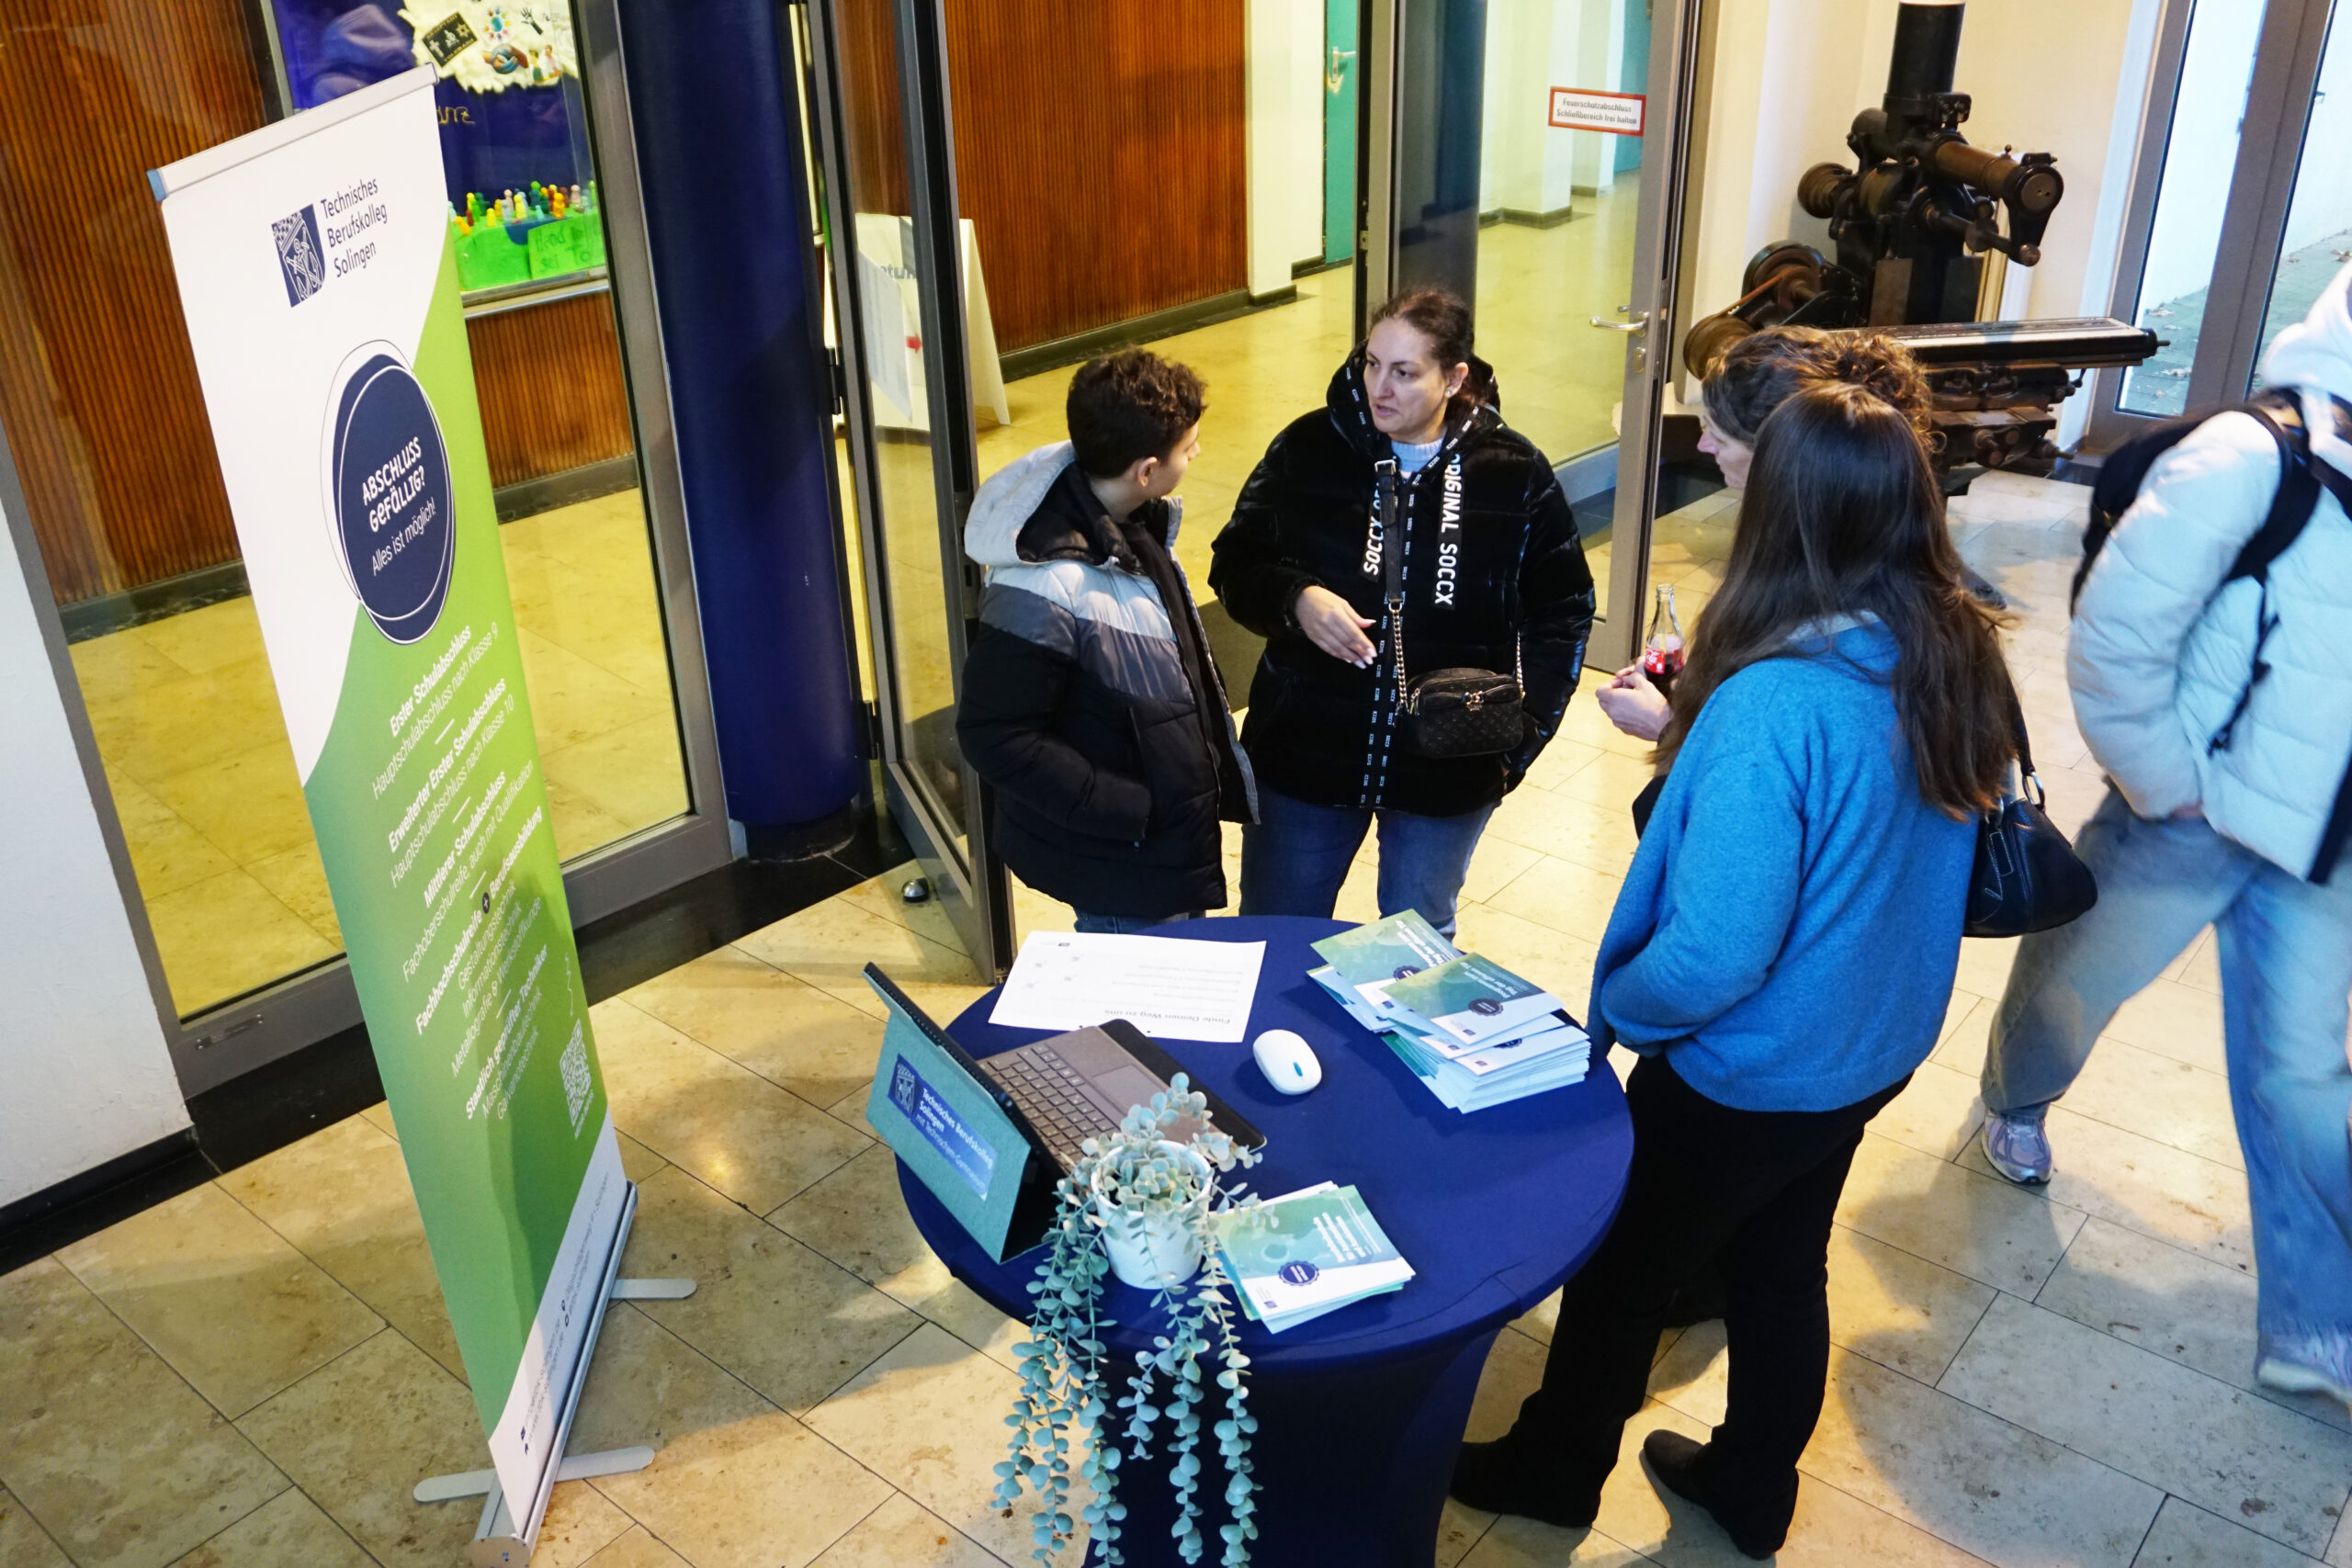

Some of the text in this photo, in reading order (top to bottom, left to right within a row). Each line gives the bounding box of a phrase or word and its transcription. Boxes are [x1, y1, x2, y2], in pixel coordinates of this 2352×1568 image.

[1556, 108, 1603, 121] Schließbereich
[1563, 97, 1632, 112] Feuerschutzabschluss
[321, 178, 379, 219] Technisches
[327, 204, 388, 248] Berufskolleg
[334, 241, 377, 277] Solingen
[362, 436, 422, 505] ABSCHLUSS
[372, 496, 435, 577] Alles ist möglich!
[1435, 543, 1457, 604] SOCCX
[372, 621, 498, 800] Hauptschulabschluss nach Klasse 9
[390, 626, 471, 737] Erster Schulabschluss
[389, 678, 505, 852] Erweiterter Erster Schulabschluss
[390, 694, 514, 888] Hauptschulabschluss nach Klasse 10
[402, 761, 533, 982] Fachoberschulreife, auch mit Qualifikation
[424, 772, 505, 908] Mittlerer Schulabschluss
[415, 806, 542, 1035] Fachhochschulreife Berufsausbildung
[459, 880, 516, 990] Gestaltungstechnik
[452, 993, 493, 1077] Metallografie
[467, 1056, 494, 1120] Staatlich
[519, 944, 548, 1002] Techniker
[920, 1100, 945, 1134] Solingen
[922, 1088, 994, 1169] Technisches Berufskolleg
